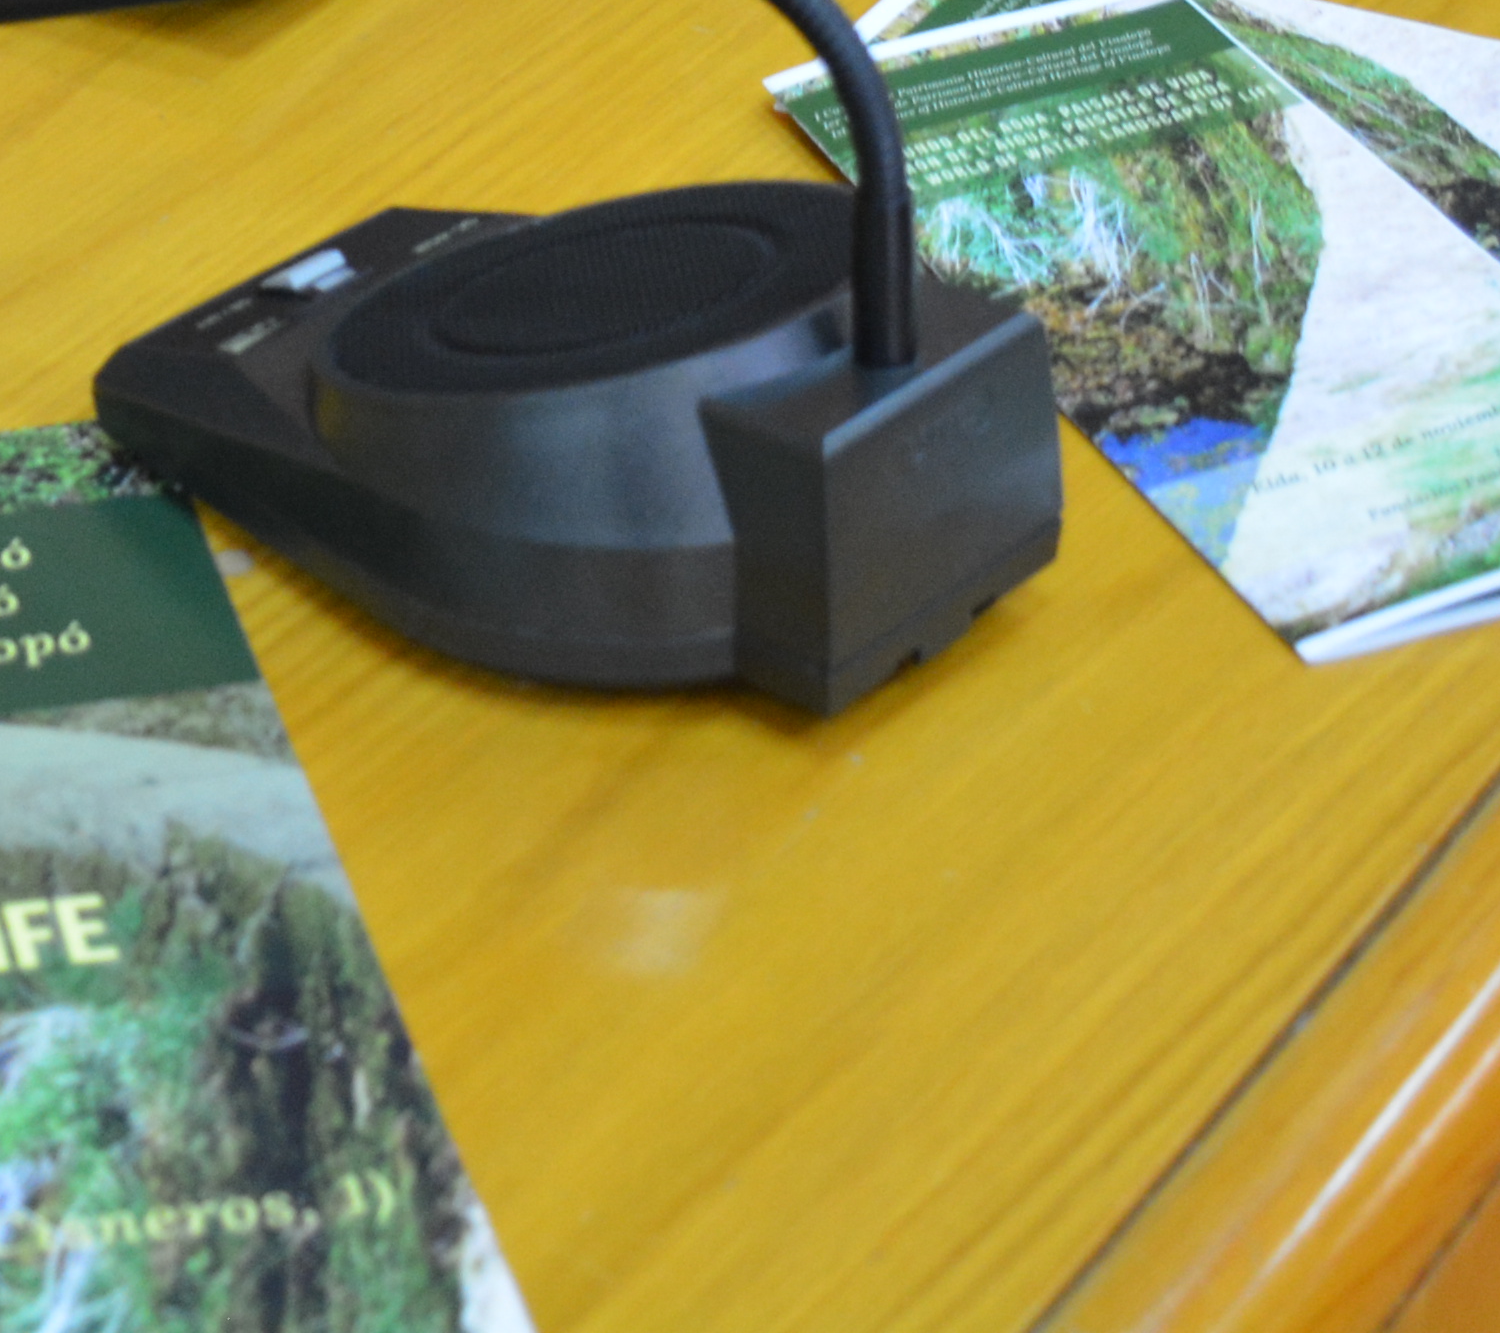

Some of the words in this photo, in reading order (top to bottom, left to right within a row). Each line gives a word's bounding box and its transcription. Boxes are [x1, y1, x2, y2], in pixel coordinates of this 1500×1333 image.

[1058, 88, 1136, 118] PAISAJE
[1138, 78, 1163, 99] DE
[1165, 67, 1214, 92] VIDA
[1156, 93, 1180, 112] DE
[1183, 79, 1231, 104] VIDA
[997, 151, 1018, 171] OF
[1100, 103, 1208, 141] LANDSCAPE
[1212, 95, 1234, 115] OF
